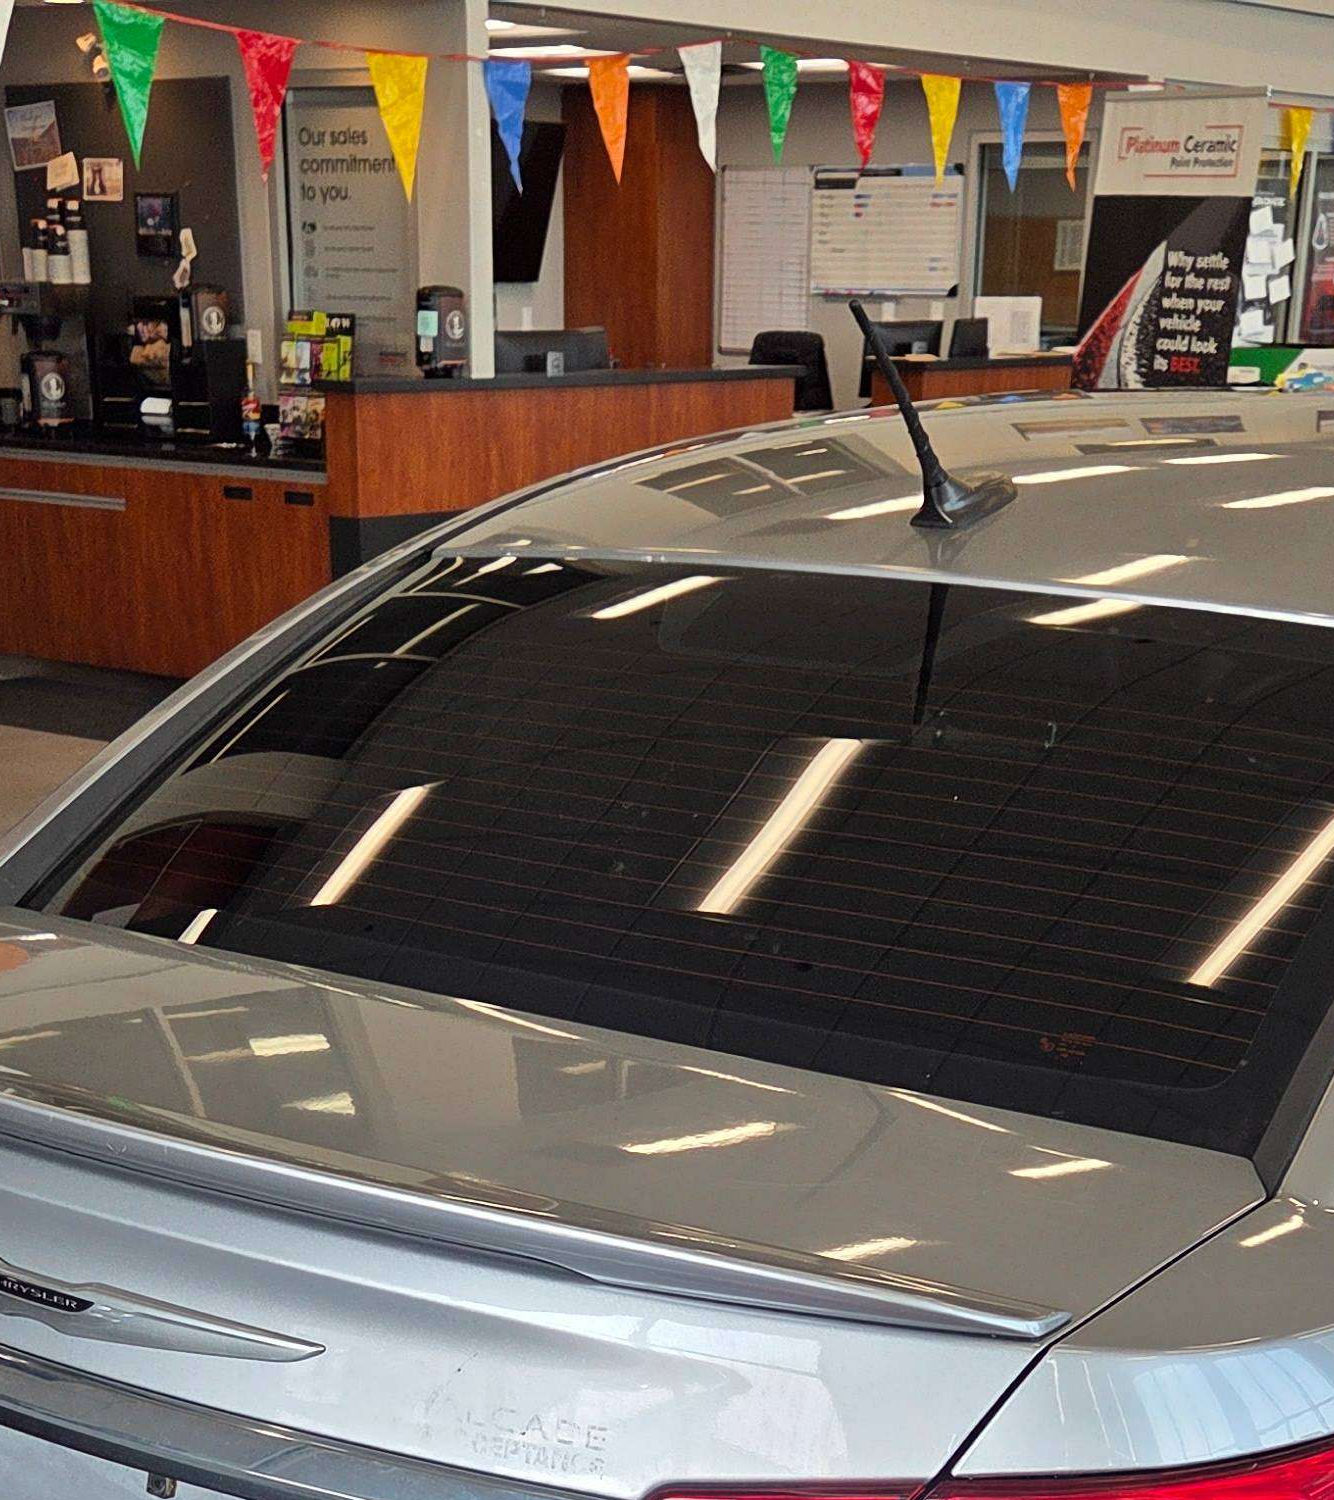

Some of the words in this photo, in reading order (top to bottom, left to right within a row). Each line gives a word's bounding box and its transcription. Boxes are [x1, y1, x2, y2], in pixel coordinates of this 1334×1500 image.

[298, 126, 327, 148] Our
[329, 127, 369, 147] sales
[1126, 134, 1181, 154] Platinum
[1183, 134, 1238, 154] Ceramic
[299, 153, 395, 175] commitment
[300, 182, 317, 202] to
[319, 184, 352, 205] you.
[1167, 250, 1195, 273] Why
[1195, 251, 1230, 271] settle
[1164, 270, 1183, 289] for
[1183, 271, 1206, 291] the
[1206, 275, 1232, 292] rest
[1161, 292, 1195, 311] when
[1195, 298, 1227, 315] your
[1158, 313, 1203, 333] vehicle
[1155, 334, 1190, 352] could
[1189, 335, 1219, 355] look
